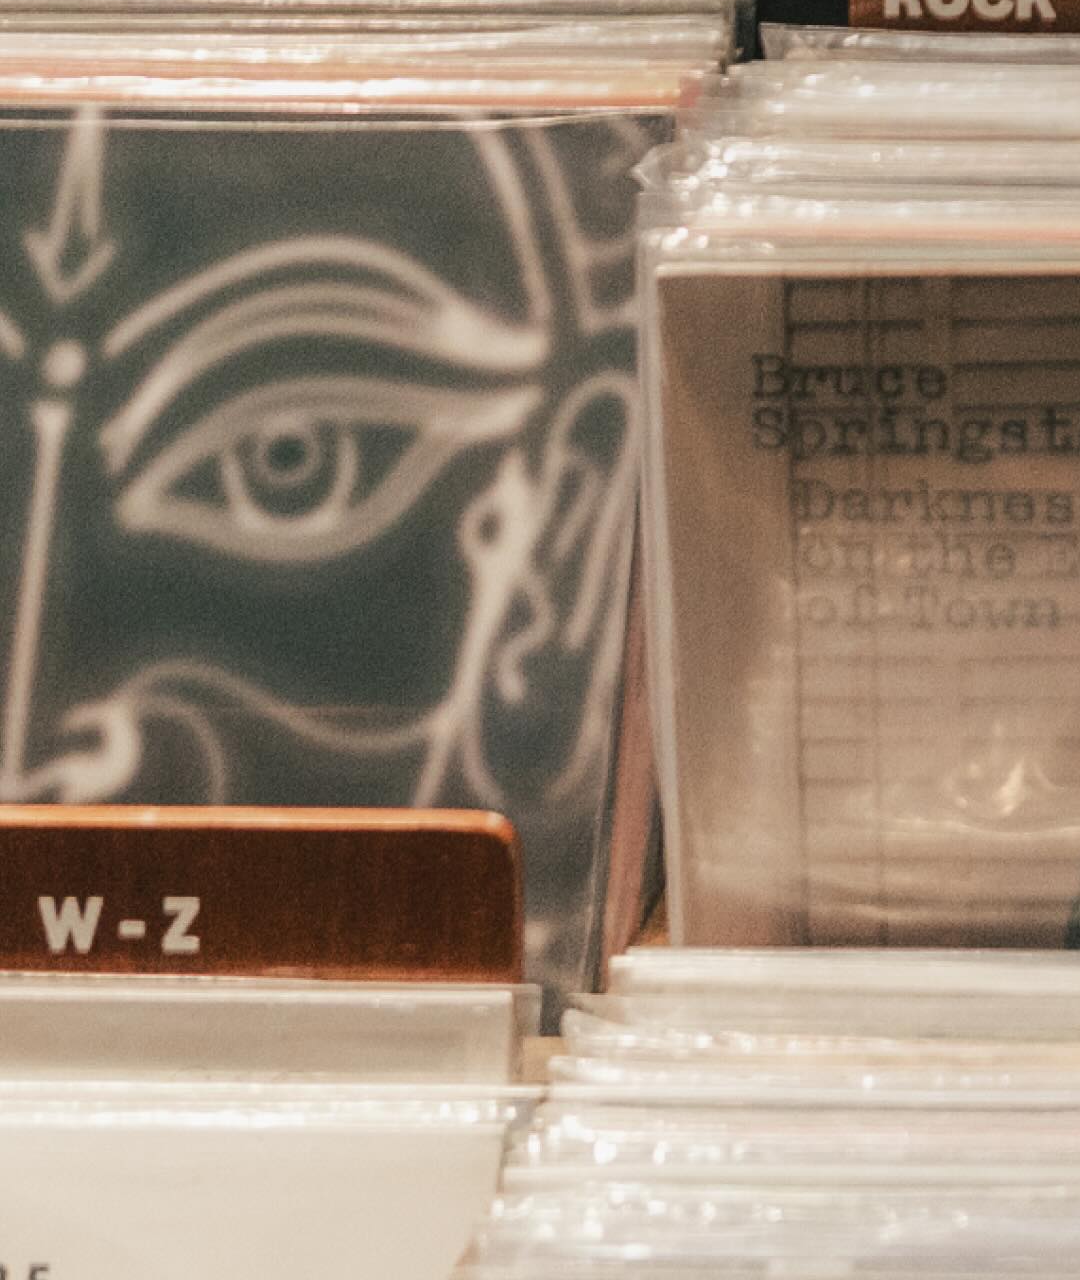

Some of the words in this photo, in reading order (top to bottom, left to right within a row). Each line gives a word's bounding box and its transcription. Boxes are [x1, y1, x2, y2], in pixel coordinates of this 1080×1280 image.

[751, 354, 948, 399] Bruce
[903, 583, 1063, 630] Town
[37, 895, 105, 955] W
[160, 895, 201, 955] Z
